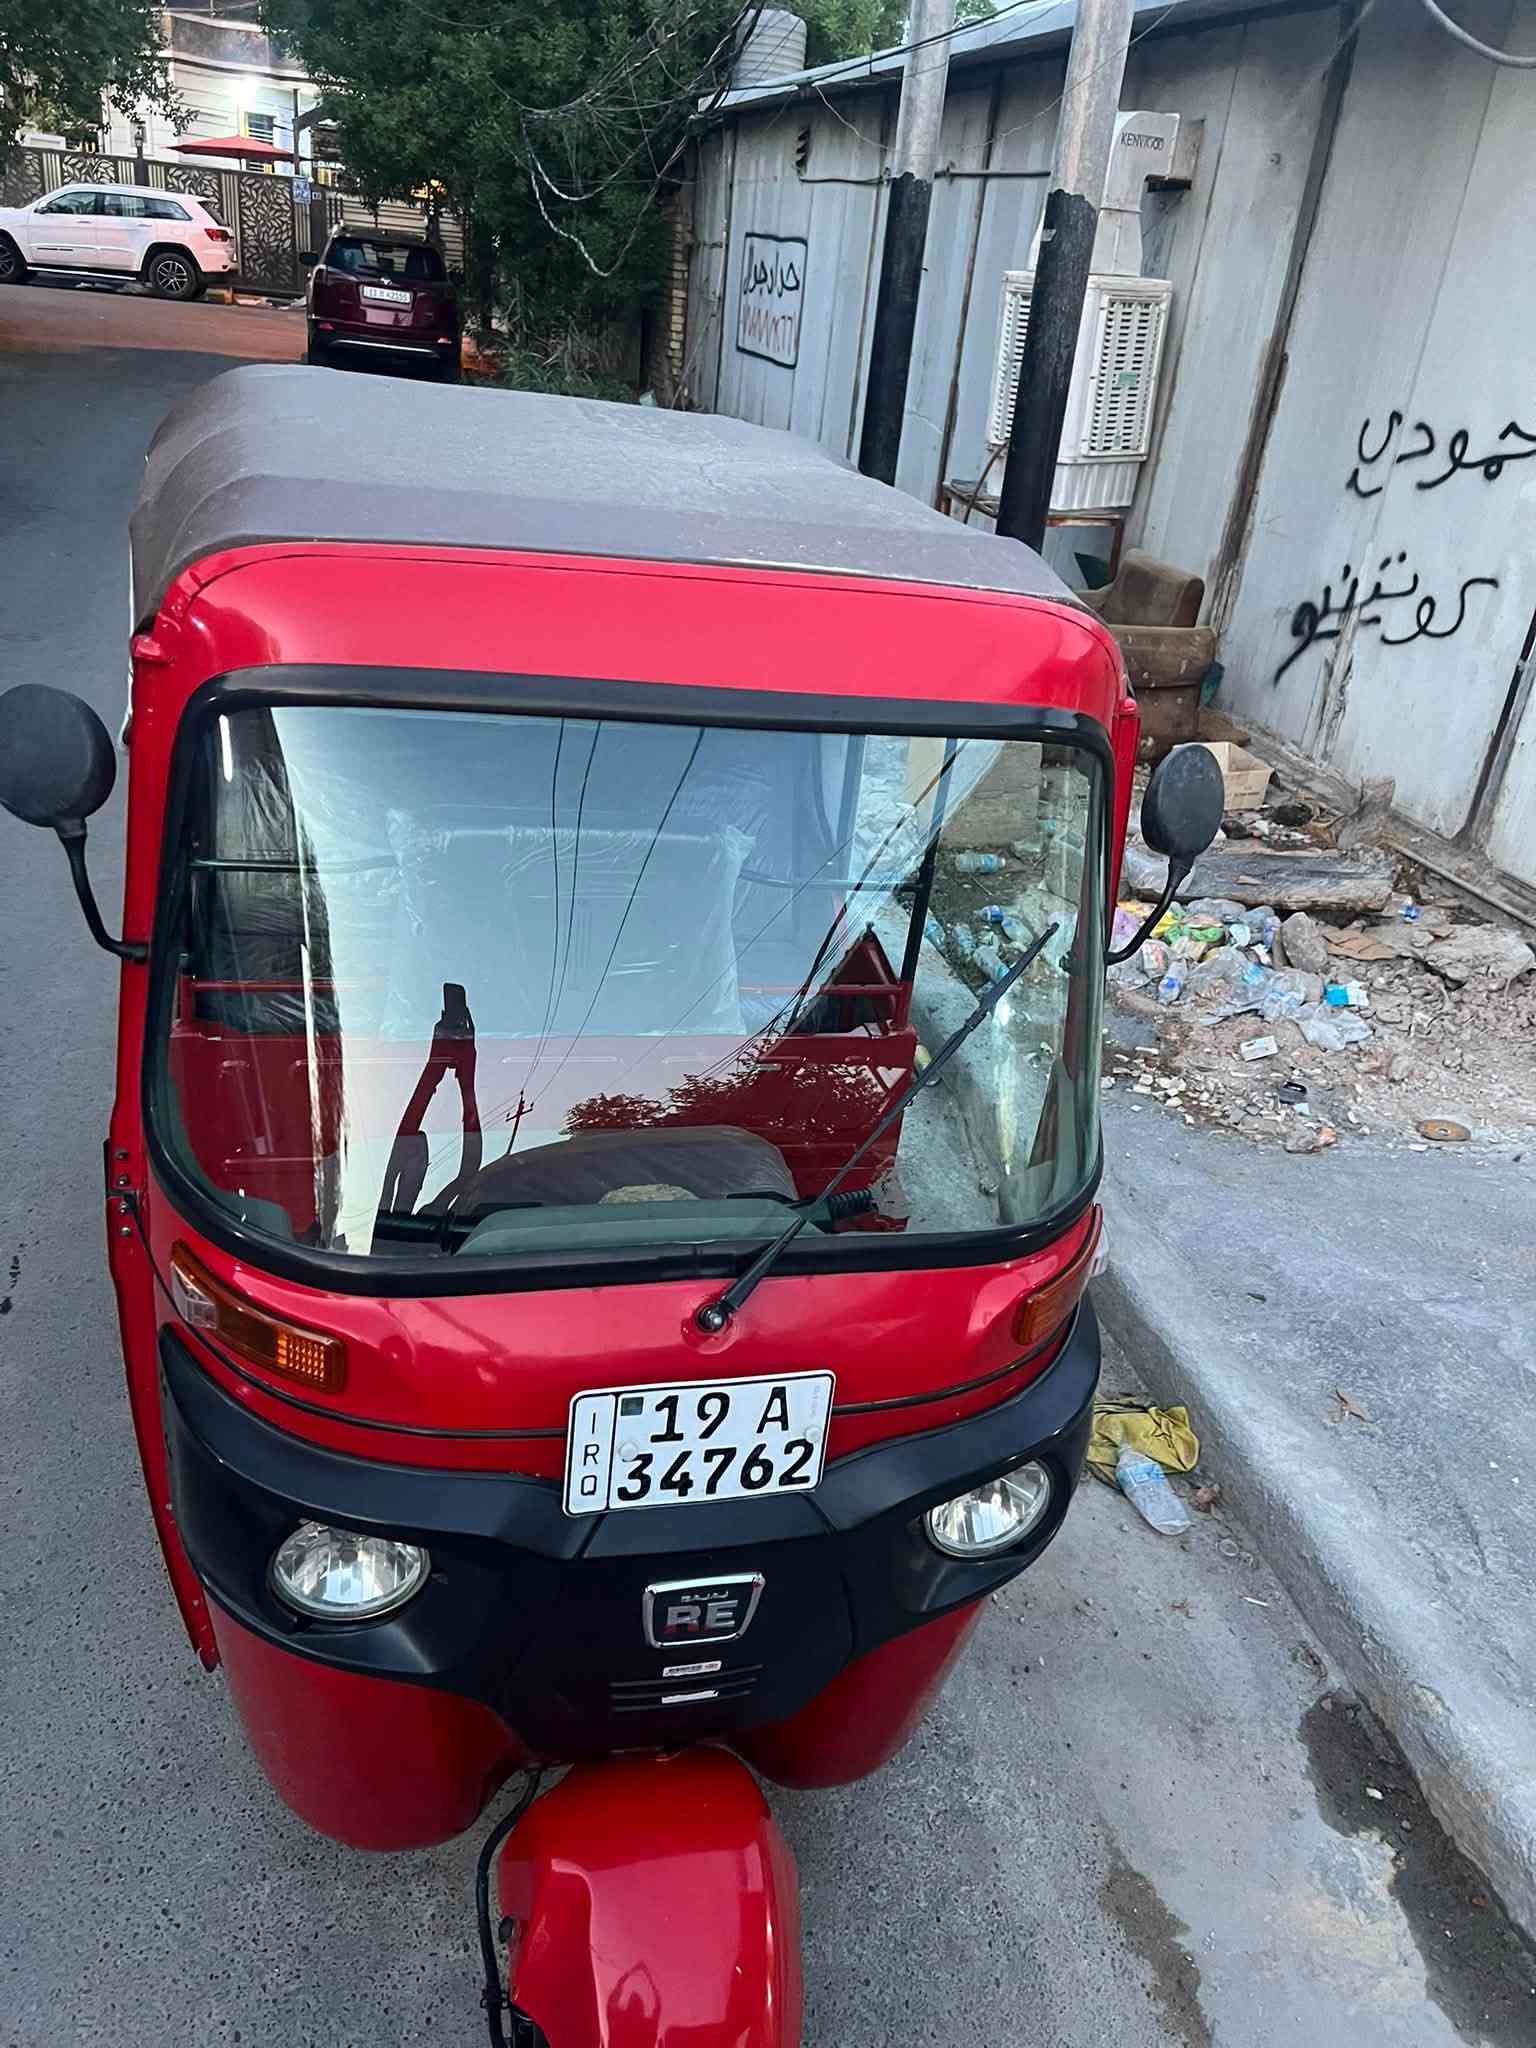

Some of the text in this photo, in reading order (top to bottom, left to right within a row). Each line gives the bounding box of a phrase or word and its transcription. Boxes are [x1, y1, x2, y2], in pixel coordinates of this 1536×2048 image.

[650, 1391, 731, 1443] 19
[756, 1386, 790, 1434] A
[581, 1412, 600, 1496] IRQ
[617, 1438, 814, 1501] 34762
[664, 1600, 738, 1632] RE
